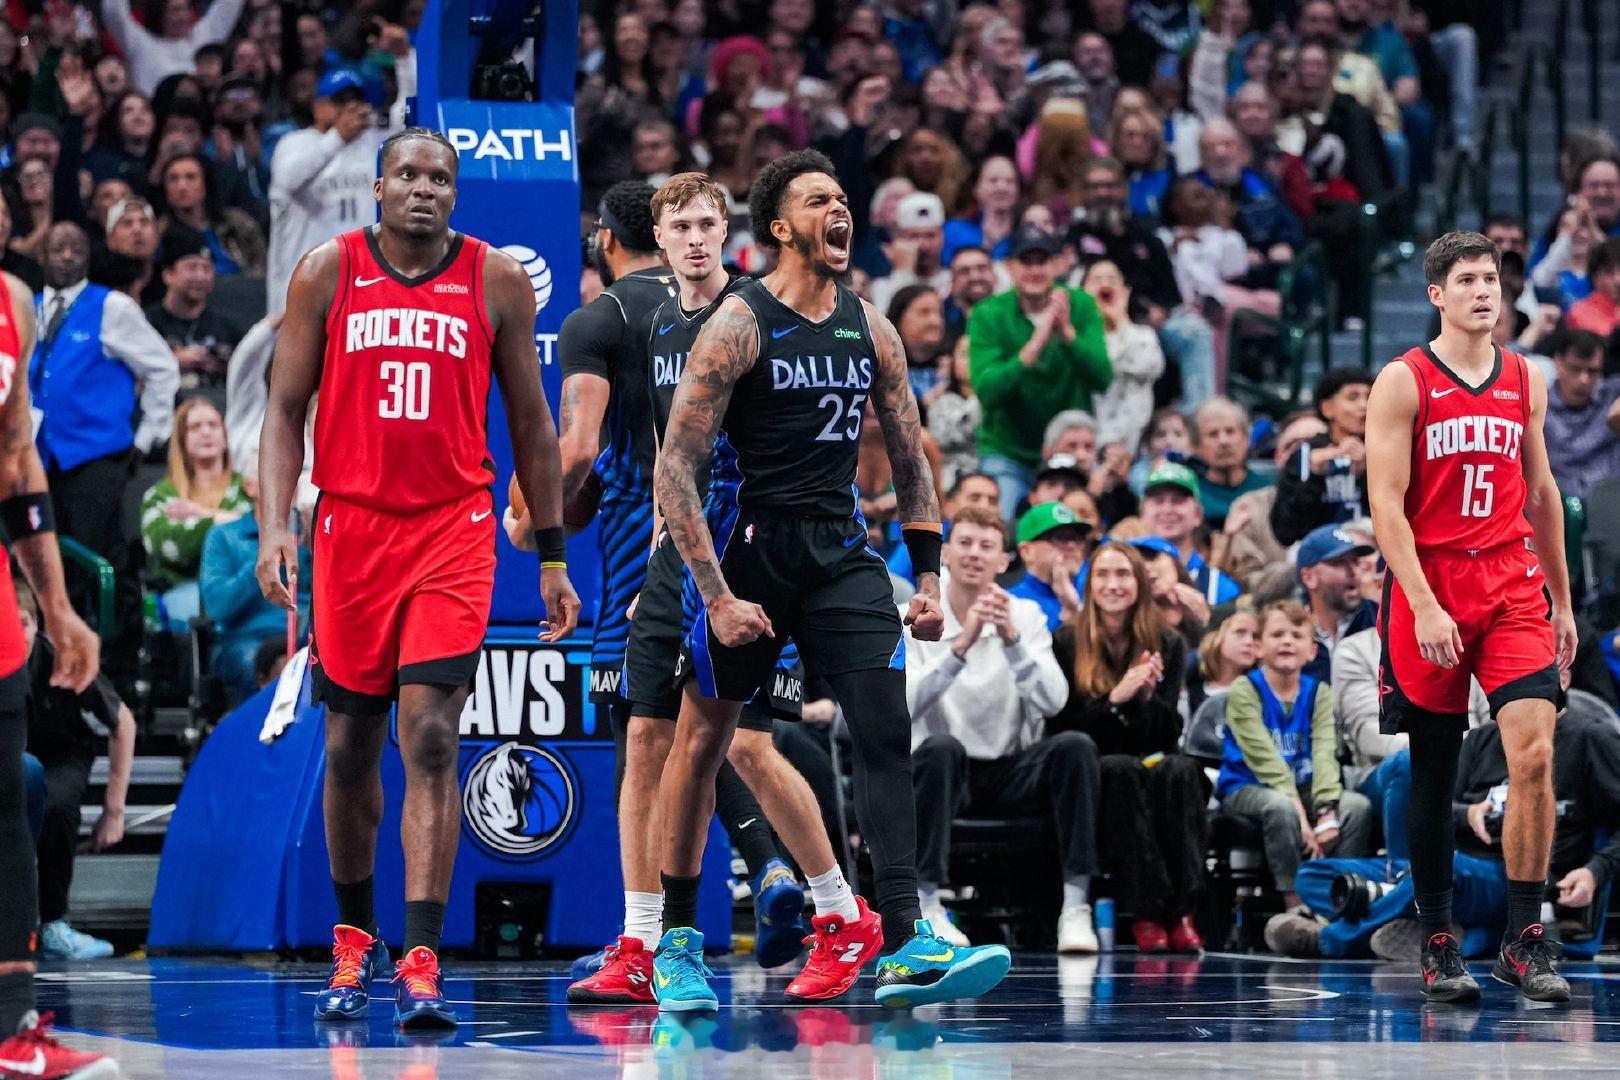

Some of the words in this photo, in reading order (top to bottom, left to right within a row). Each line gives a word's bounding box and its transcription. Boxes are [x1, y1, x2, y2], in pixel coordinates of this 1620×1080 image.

[447, 127, 572, 161] PATH
[346, 307, 468, 359] ROCKETS
[834, 327, 861, 339] chime
[653, 352, 690, 387] DAL
[769, 355, 872, 390] DALLAS
[378, 360, 431, 421] 30
[815, 392, 867, 441] 25
[1426, 415, 1524, 461] ROCKETS
[1461, 463, 1494, 517] 15
[458, 649, 566, 736] AVS
[588, 670, 621, 692] MAV
[772, 673, 803, 702] MAVS
